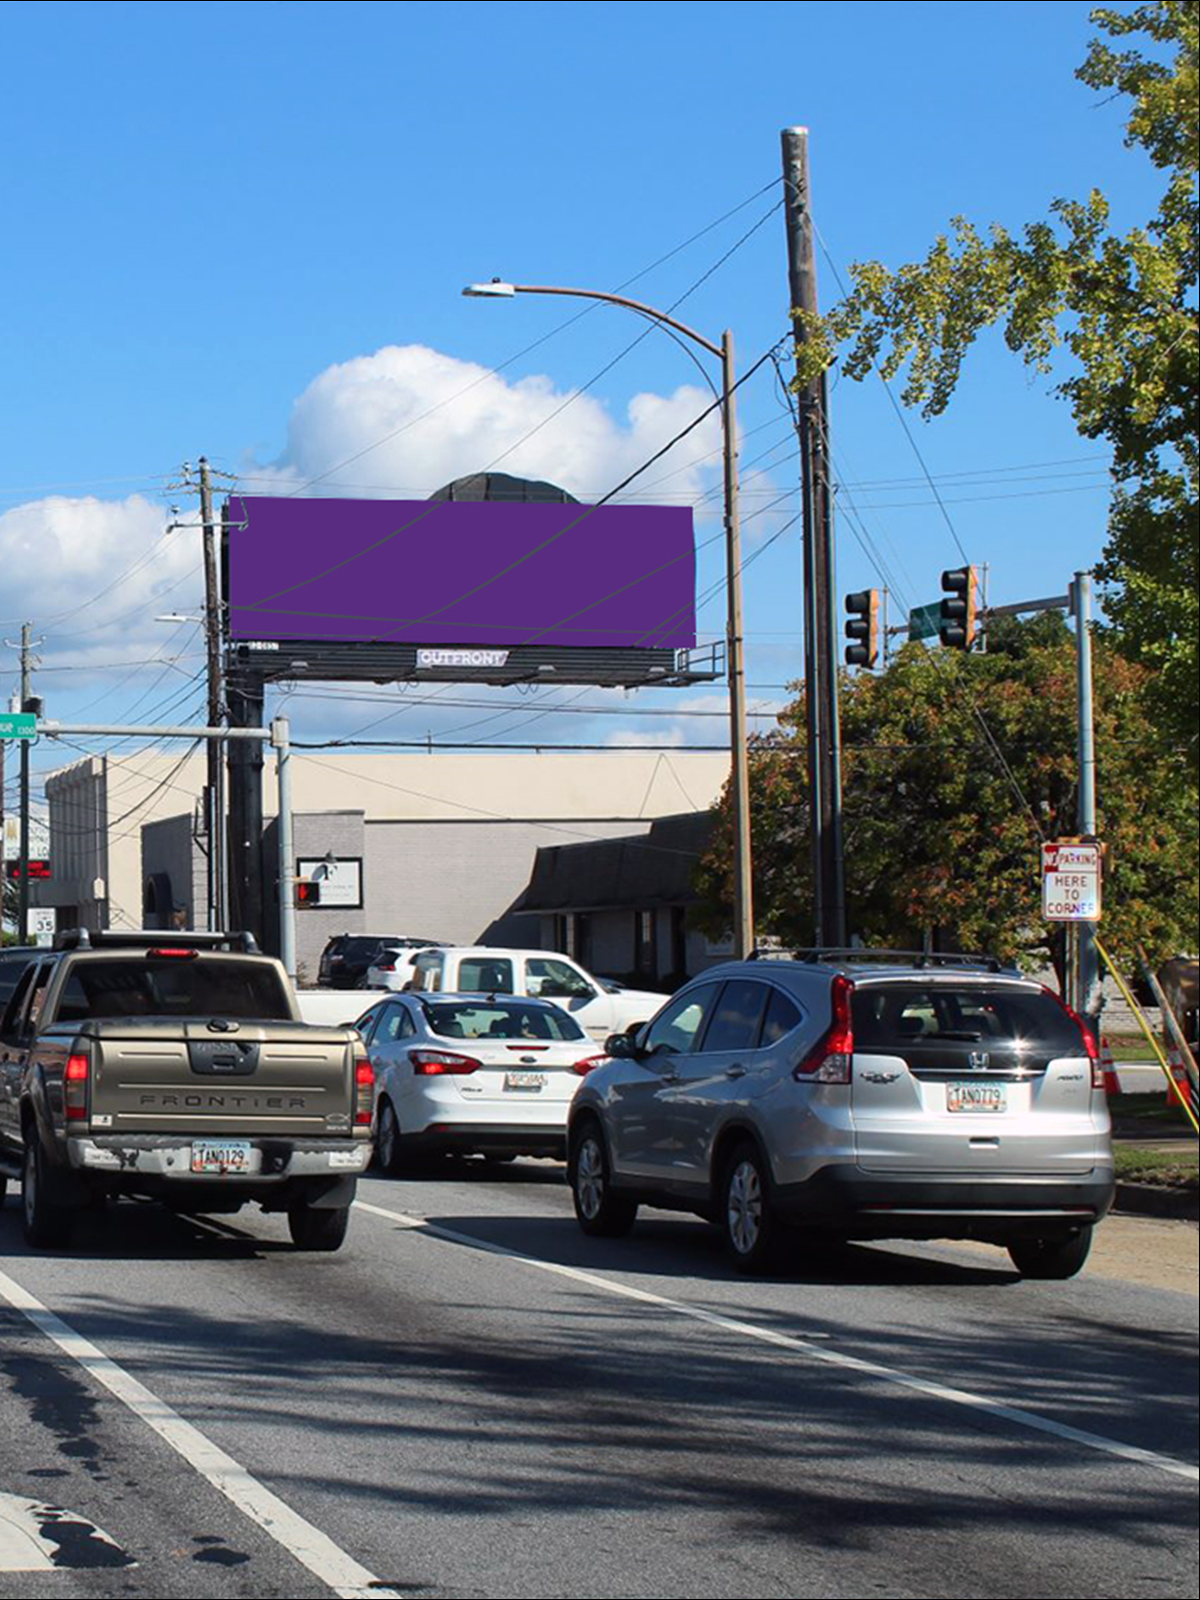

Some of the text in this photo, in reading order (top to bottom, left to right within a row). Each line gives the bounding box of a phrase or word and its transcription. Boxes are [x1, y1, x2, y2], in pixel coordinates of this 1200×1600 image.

[420, 651, 503, 666] OUTFRONT
[1059, 852, 1096, 866] PARKING
[1055, 875, 1087, 888] HERE
[1064, 888, 1080, 901] TO
[1047, 901, 1094, 915] CORNER
[36, 921, 54, 932] 35
[140, 1095, 306, 1109] FRONTIER
